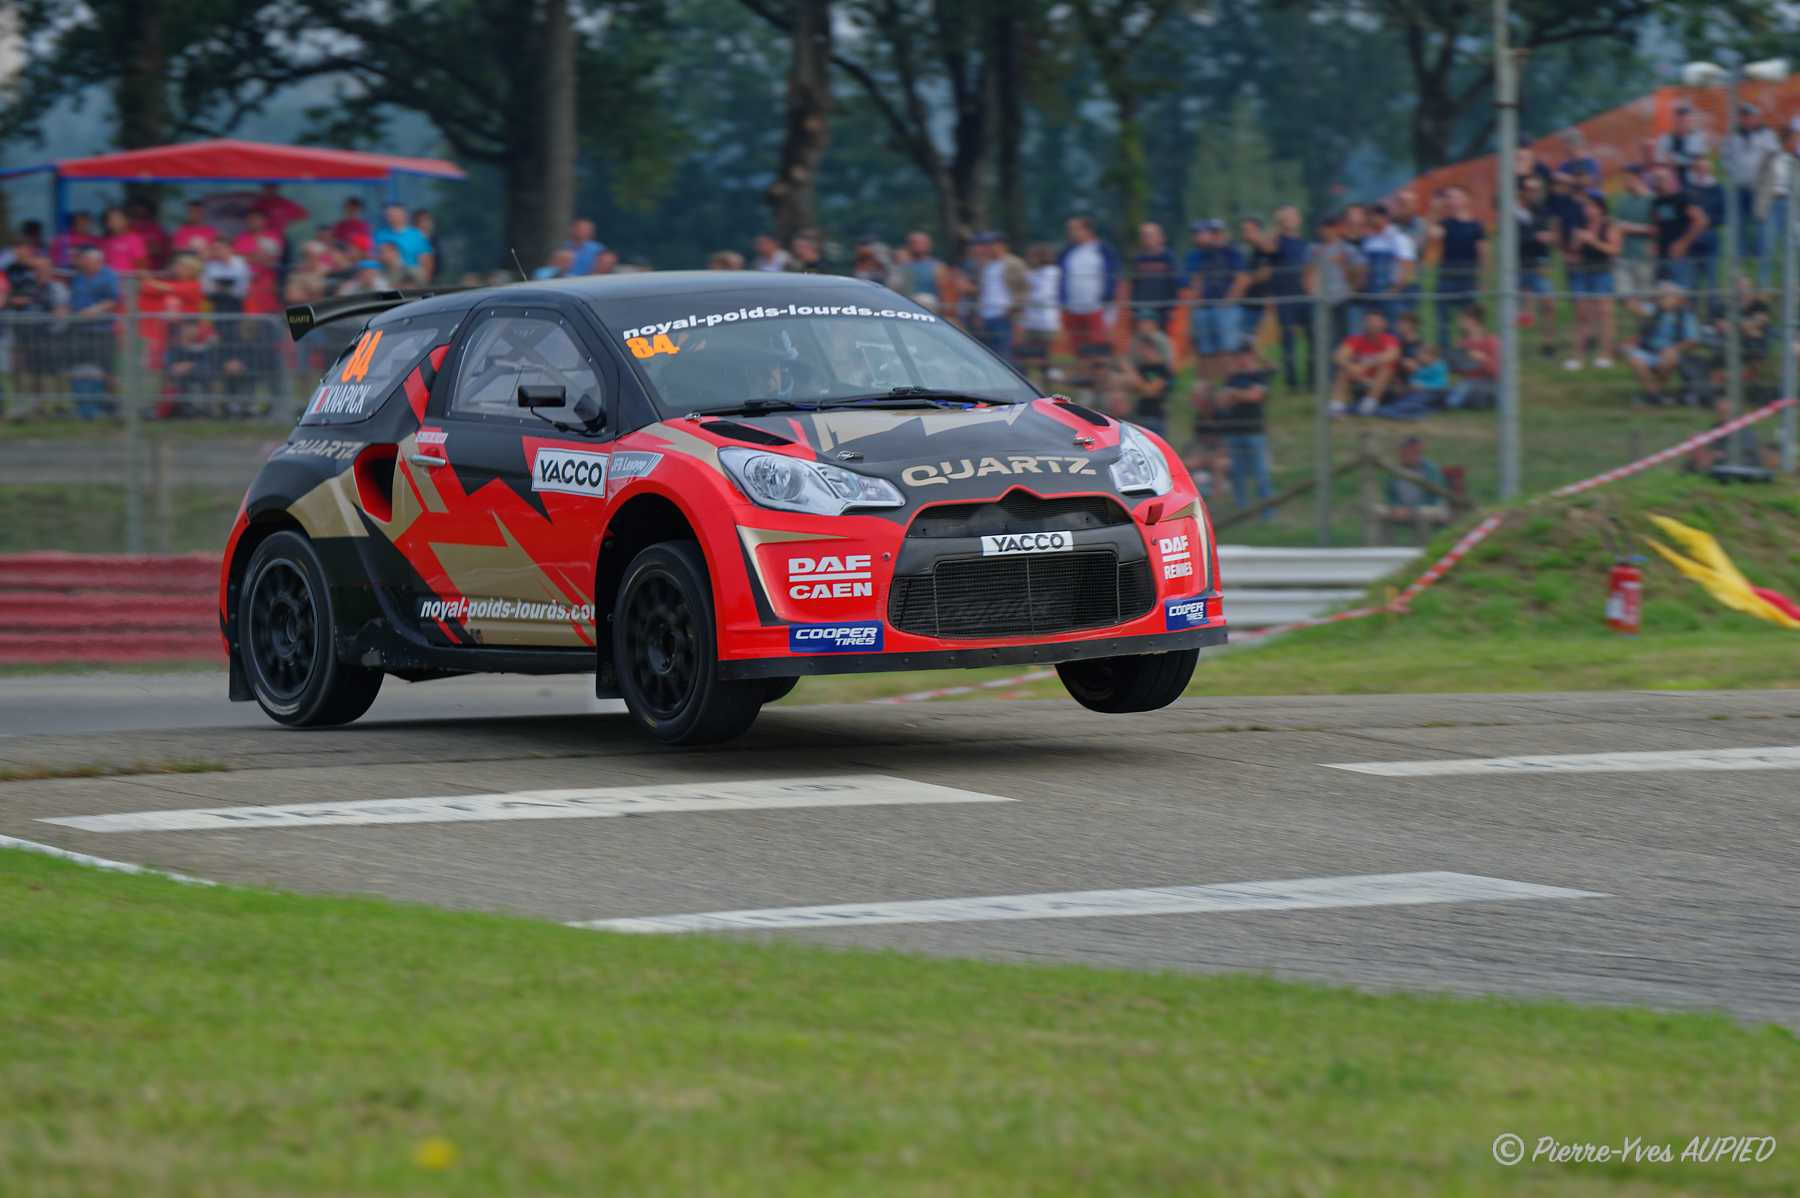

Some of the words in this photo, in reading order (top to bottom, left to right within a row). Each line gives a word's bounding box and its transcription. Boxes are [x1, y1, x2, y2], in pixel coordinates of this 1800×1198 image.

[623, 304, 937, 340] noyal-poids-lourds.com
[341, 329, 384, 384] 84
[626, 334, 680, 360] 84
[320, 384, 372, 415] KNAPICK
[540, 459, 603, 488] YACCO
[902, 455, 1097, 487] QUARTZ
[991, 532, 1064, 553] YACCO
[1160, 536, 1189, 553] DAF
[789, 555, 872, 573] DAF
[789, 582, 873, 600] CAEN
[1169, 602, 1204, 616] COOPER
[795, 626, 878, 640] COOPER
[835, 637, 876, 646] TIRES
